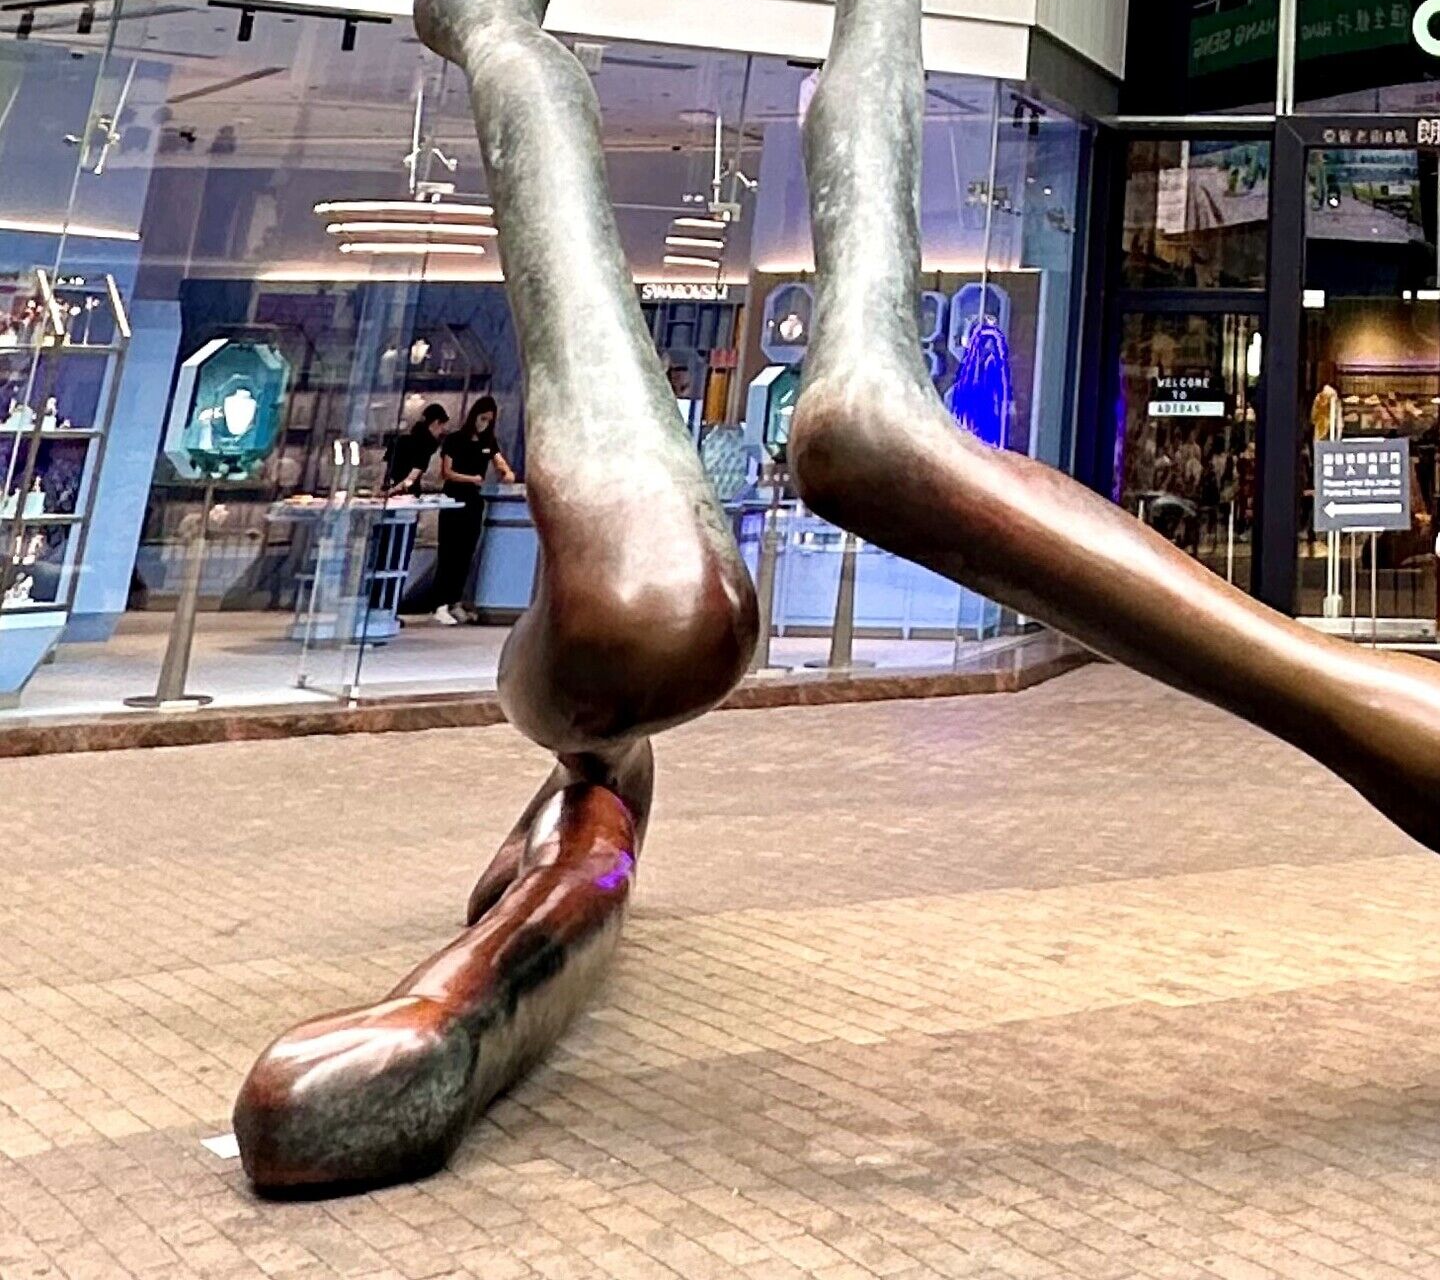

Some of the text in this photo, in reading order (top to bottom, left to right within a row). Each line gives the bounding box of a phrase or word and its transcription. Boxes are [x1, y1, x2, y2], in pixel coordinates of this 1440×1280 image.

[1157, 377, 1210, 389] WELCOME
[1172, 390, 1188, 400] TO
[1157, 403, 1201, 414] ADIDAS
